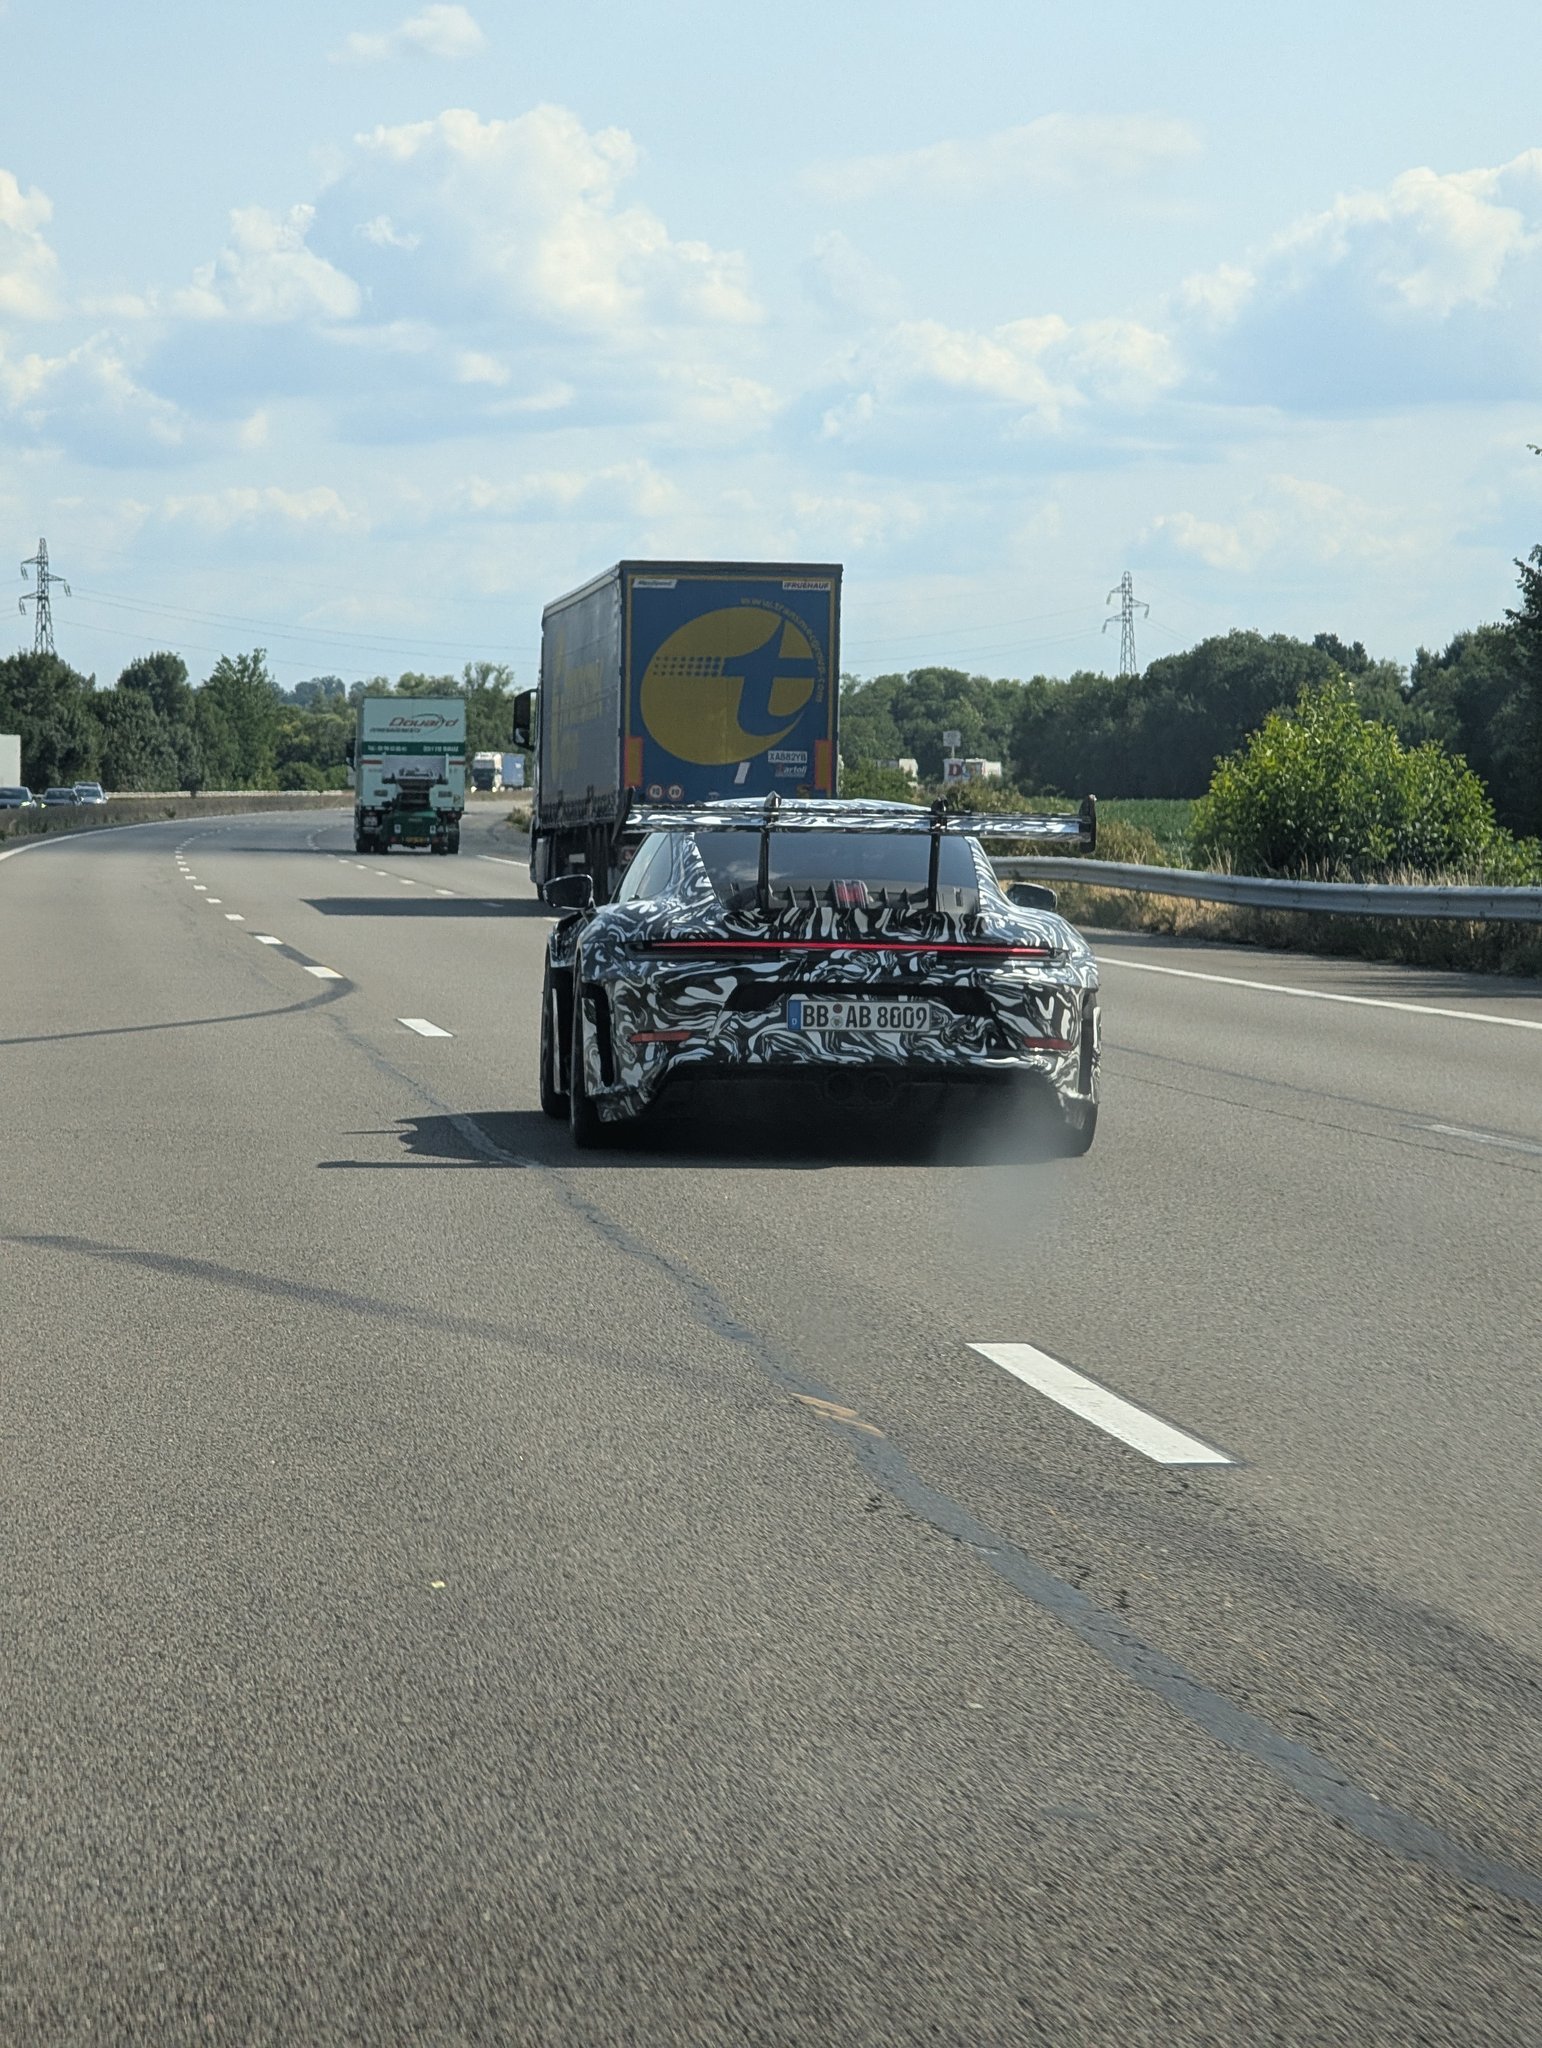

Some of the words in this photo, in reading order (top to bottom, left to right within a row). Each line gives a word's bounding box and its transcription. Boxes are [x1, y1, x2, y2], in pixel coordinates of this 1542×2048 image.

[803, 1005, 829, 1028] BB
[845, 1005, 872, 1029] AB
[877, 1006, 928, 1030] 8009
